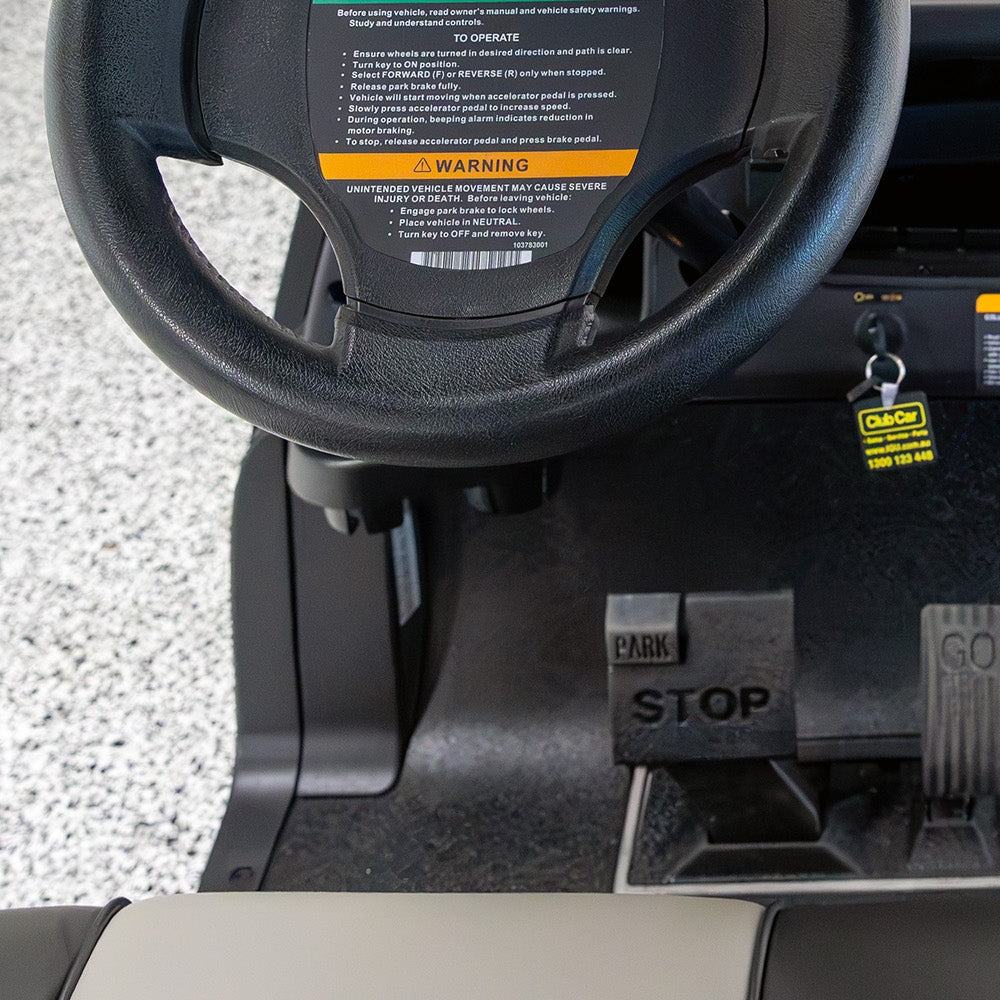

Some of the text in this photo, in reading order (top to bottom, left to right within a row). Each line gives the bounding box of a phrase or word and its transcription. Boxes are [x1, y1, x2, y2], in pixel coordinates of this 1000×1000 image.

[337, 5, 640, 18] Before using vehicle, read owner's manual and vehicle safety warnings.
[348, 18, 484, 28] Study and understand controls.
[453, 33, 520, 42] TO OPERATE
[353, 50, 386, 58] Ensure
[386, 50, 419, 58] wheels
[436, 49, 467, 57] turned
[468, 49, 477, 57] in
[478, 48, 513, 57] desired
[514, 48, 555, 56] direction
[556, 47, 574, 55] and
[575, 47, 595, 56] path
[352, 61, 374, 69] Turn
[375, 61, 391, 70] key
[403, 60, 418, 68] ON
[419, 60, 460, 69] position.
[351, 70, 380, 79] Select
[381, 70, 430, 79] FORWARD
[432, 70, 445, 80] (F)
[457, 69, 502, 78] REVERSE
[504, 69, 518, 79] (R)
[519, 69, 539, 78] only
[566, 68, 606, 77] stopped.
[350, 82, 461, 92] Release park brake fully.
[349, 93, 384, 102] Vehicle
[384, 93, 401, 101] will
[426, 93, 460, 102] moving
[487, 92, 540, 100] accelerator
[540, 91, 566, 101] pedal
[567, 91, 576, 99] is
[577, 90, 617, 100] pressed.
[348, 104, 380, 114] Slowly
[380, 105, 407, 114] press
[408, 104, 461, 112] accelerator
[462, 103, 488, 113] pedal
[499, 103, 539, 111] increase
[540, 102, 571, 111] speed.
[347, 115, 379, 125] During
[380, 115, 427, 125] operation,
[429, 115, 466, 124] beeping
[495, 114, 538, 122] indicates
[539, 113, 583, 121] reduction
[347, 126, 414, 136] motor braking.
[345, 134, 602, 147] To stop, release accelerator pedal and press brake pedal.
[436, 159, 529, 172] WARNING
[346, 182, 607, 193] UNINTENDED VEHICLE MOVEMENT MAY CAUSE SEVERE
[374, 193, 572, 203] INJURY OR DEATH. Before leaving vehicle:
[400, 205, 554, 216] Engage park brake to lock wheels.
[398, 217, 520, 226] Place vehicle in NEUTRAL.
[398, 230, 420, 238] Turn
[421, 230, 438, 240] key
[439, 230, 449, 238] to
[450, 229, 470, 238] OFF
[471, 229, 489, 238] and
[526, 229, 546, 238] key.
[866, 410, 917, 429] Club Car
[615, 634, 669, 660] PARK
[942, 632, 996, 671] GO
[632, 686, 770, 724] STOP
